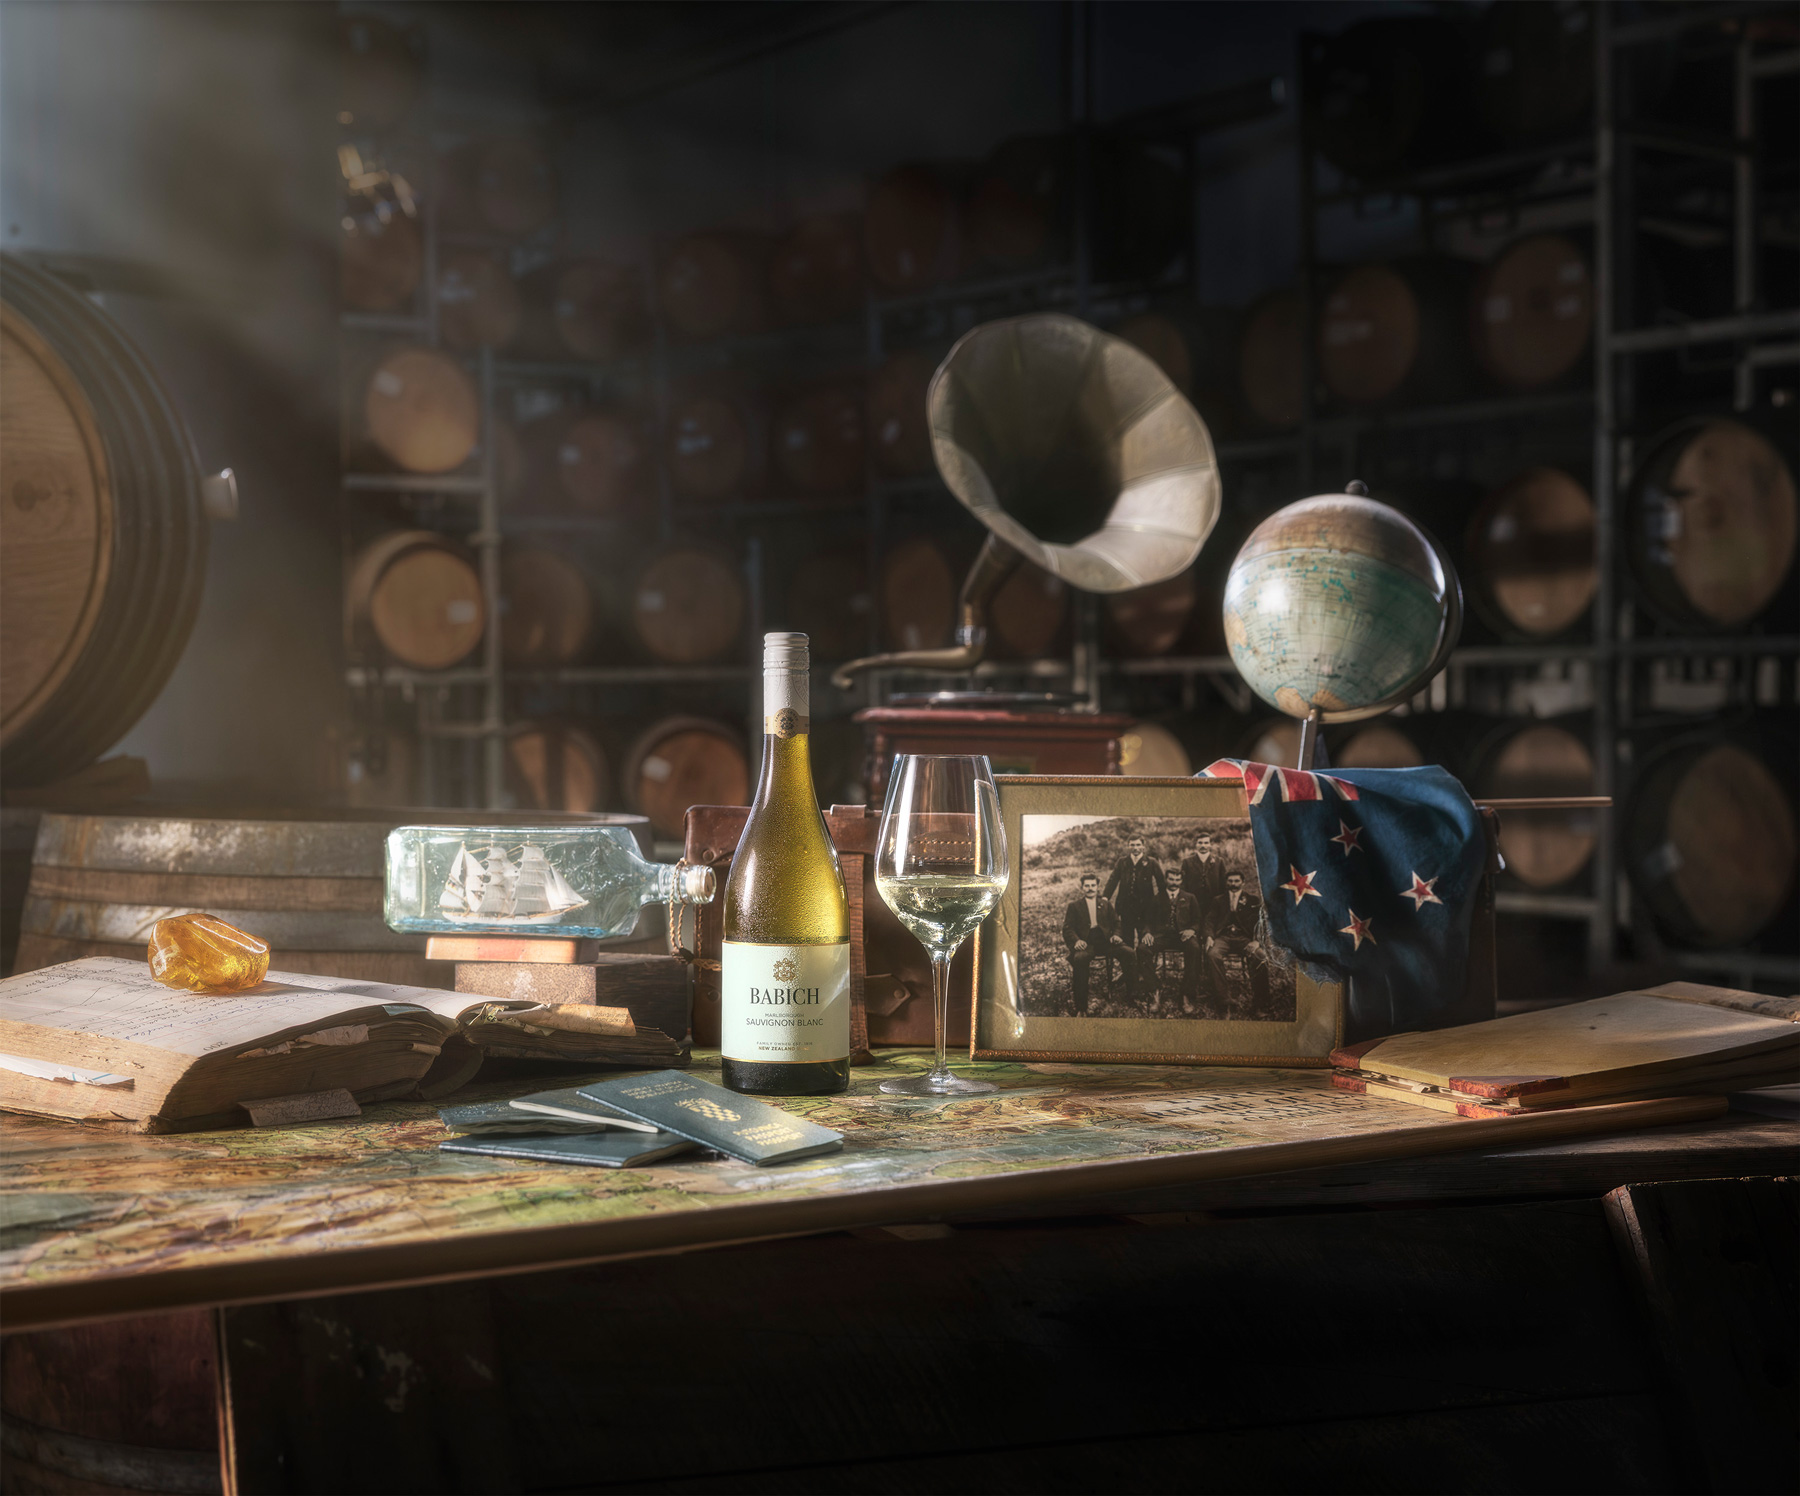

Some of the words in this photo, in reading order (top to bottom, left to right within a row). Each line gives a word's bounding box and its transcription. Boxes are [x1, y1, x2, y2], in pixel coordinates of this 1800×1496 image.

[750, 987, 820, 1005] BABICH
[746, 1018, 795, 1027] SAUVIGNON
[797, 1018, 824, 1027] BLANC
